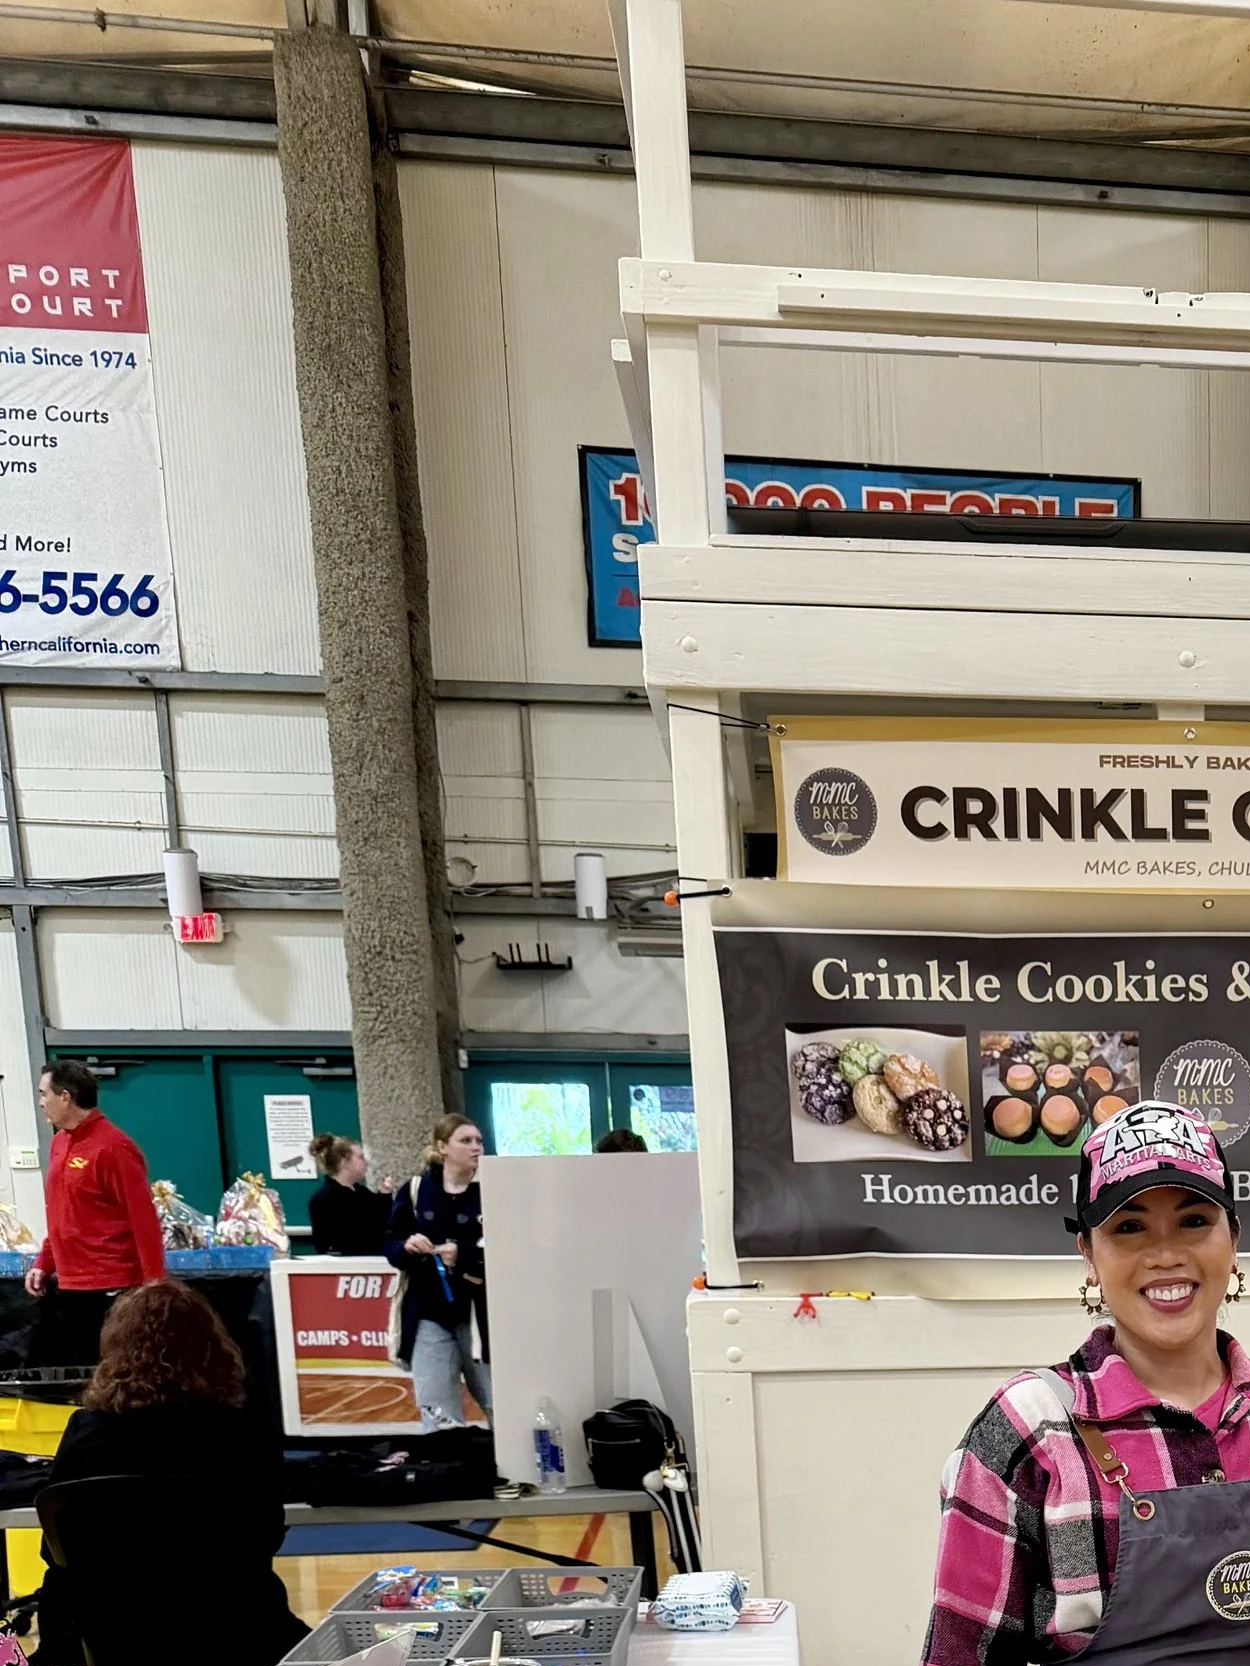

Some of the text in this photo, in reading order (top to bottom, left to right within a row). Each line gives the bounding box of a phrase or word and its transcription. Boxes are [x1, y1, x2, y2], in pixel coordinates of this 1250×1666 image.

[31, 347, 137, 369] Since 1974
[45, 405, 109, 423] Courts
[15, 535, 71, 553] More!
[1099, 755, 1199, 770] FRESHLY
[813, 805, 859, 820] BAKES
[900, 785, 1212, 844] CRINKLE
[1084, 860, 1132, 877] MMC
[1136, 860, 1202, 879] BAKES,
[811, 957, 1001, 1003] Crinkle
[1016, 959, 1209, 1003] Cookies
[1177, 1088, 1235, 1105] BAKES
[1174, 1148, 1212, 1171] ARTS
[861, 1173, 1058, 1206] Homemade
[336, 1275, 382, 1299] FOR
[296, 1330, 349, 1346] CAMPS
